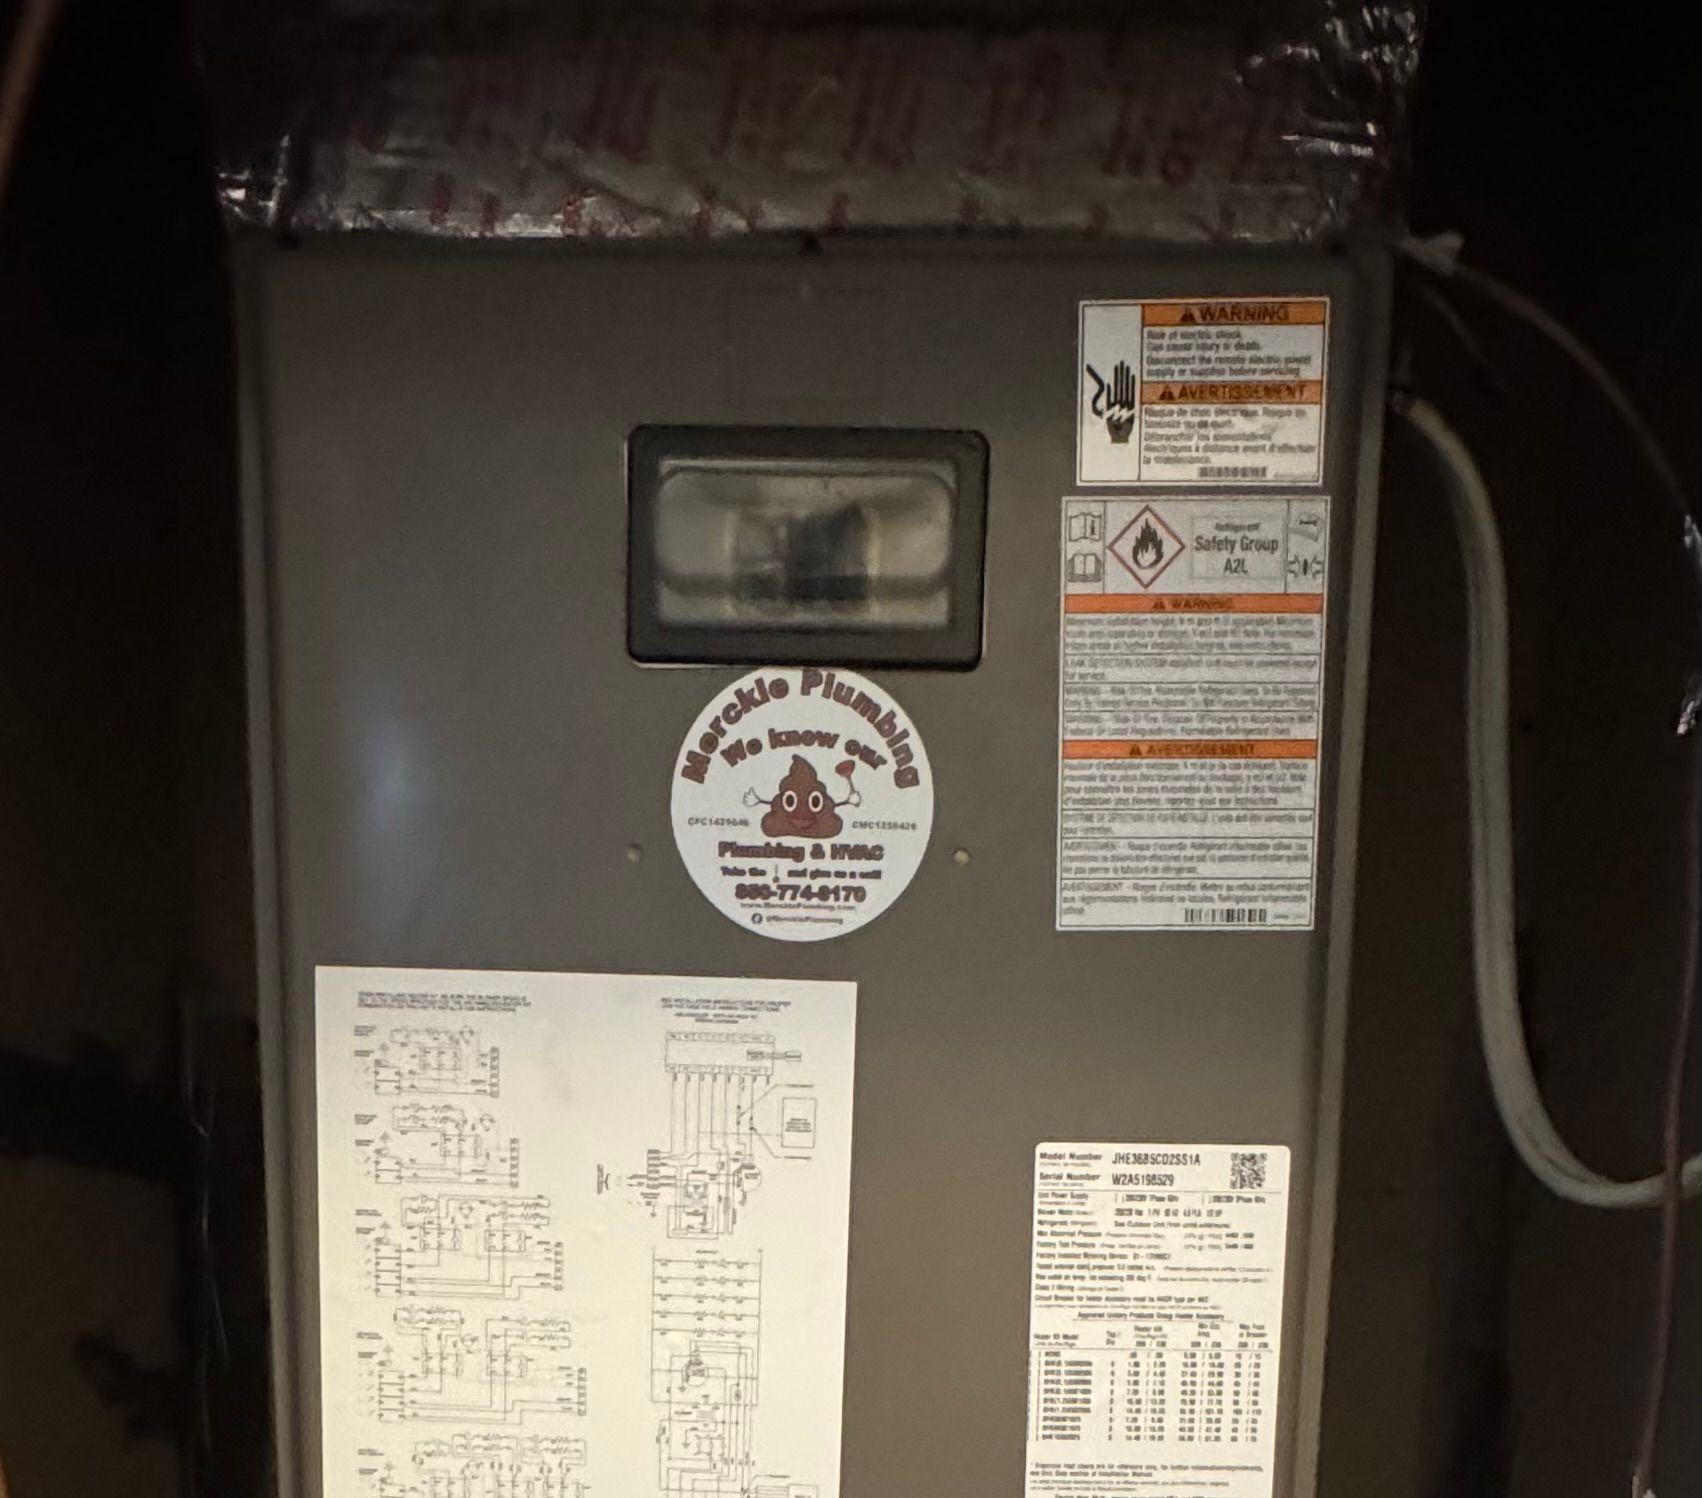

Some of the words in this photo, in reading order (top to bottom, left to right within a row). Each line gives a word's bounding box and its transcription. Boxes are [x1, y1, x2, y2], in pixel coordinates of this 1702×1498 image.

[1200, 305, 1290, 322] WARNING
[1178, 384, 1307, 401] AVERTISSEMENT
[1195, 535, 1236, 555] Safety
[1240, 534, 1279, 556] Group
[1224, 559, 1249, 574] A2L
[801, 669, 921, 790] Plumbing
[768, 728, 841, 750] know
[718, 841, 806, 863] Plumbing
[810, 843, 826, 860] &
[831, 843, 885, 861] HVAC
[1040, 1152, 1066, 1161] Model
[1069, 1152, 1103, 1162] Number
[1039, 1172, 1064, 1182] Serial
[1067, 1172, 1102, 1183] Number
